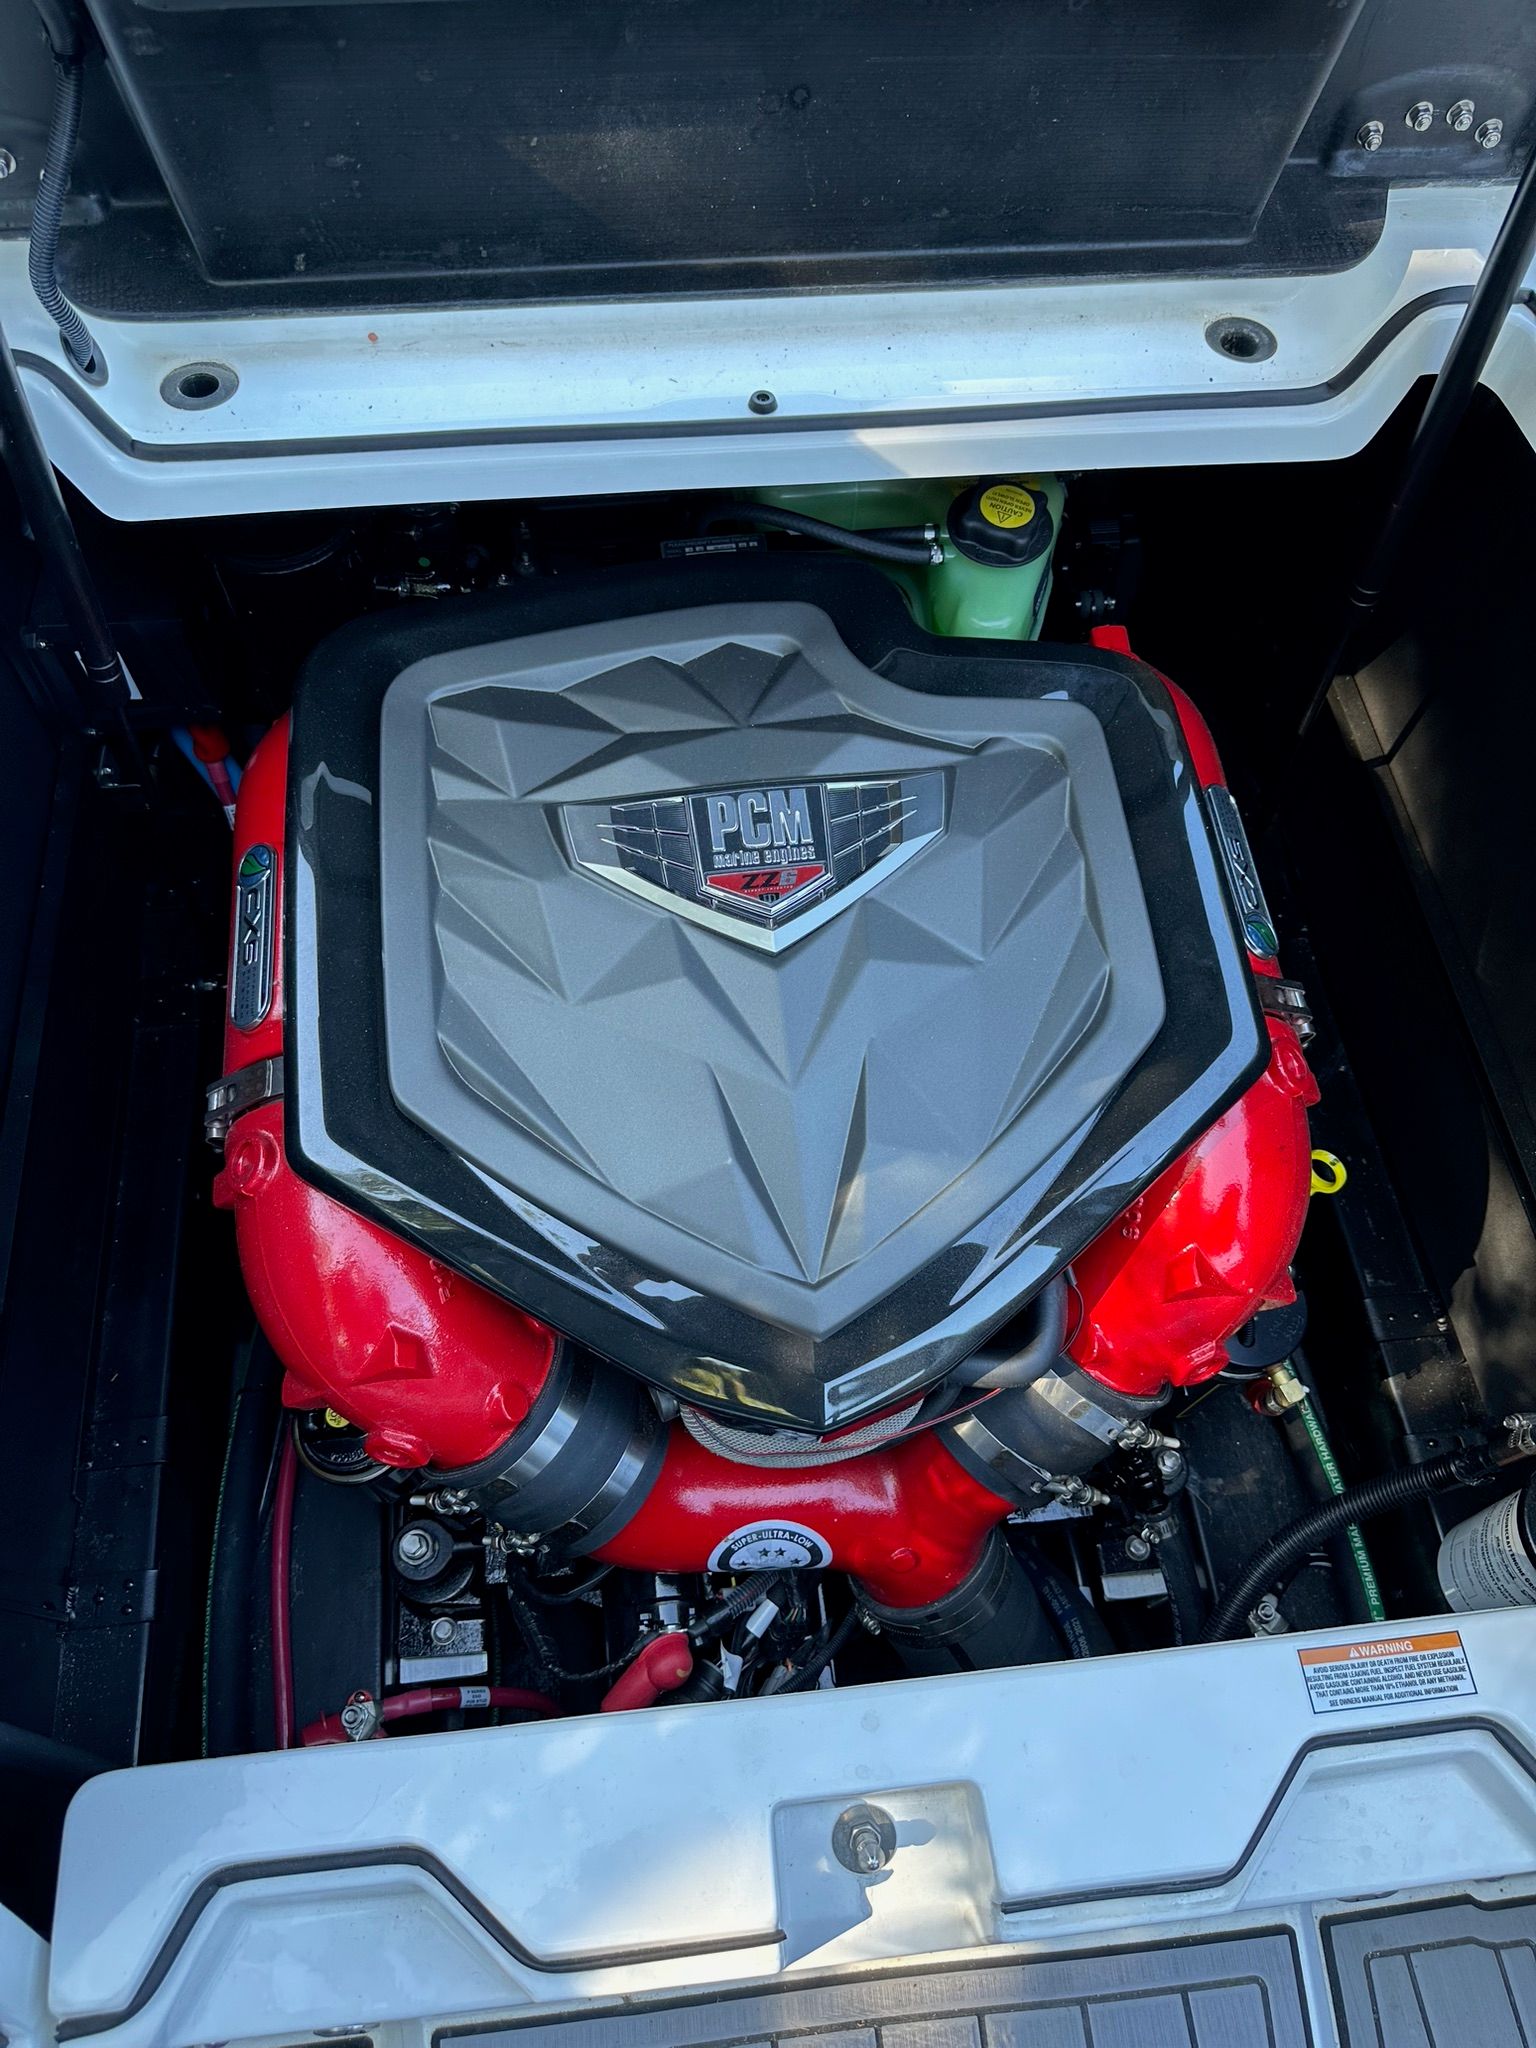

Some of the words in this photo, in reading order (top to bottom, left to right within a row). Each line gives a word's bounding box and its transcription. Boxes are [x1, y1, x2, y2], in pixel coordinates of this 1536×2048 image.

[989, 502, 1023, 517] CAUTION
[1014, 505, 1032, 514] NEVER
[1016, 498, 1030, 507] OPEN
[707, 788, 813, 851] PCM
[713, 850, 760, 868] marine
[764, 845, 816, 865] engines
[1326, 1462, 1345, 1494] ATER
[731, 1530, 814, 1551] SUPER-ULTRA-LOW
[1510, 1552, 1525, 1576] ENGINE
[1357, 1551, 1380, 1605] PREMIUM
[1358, 1640, 1413, 1657] WARNING
[1306, 1673, 1333, 1683] RESULTING
[1334, 1672, 1348, 1680] FROM
[1349, 1670, 1370, 1679] LEAKING
[1383, 1665, 1404, 1673] INSPECT
[1405, 1663, 1417, 1671] FUEL
[1417, 1661, 1437, 1669] SYSTEM
[1329, 1664, 1350, 1672] SERIOUS
[1350, 1661, 1368, 1670] INJURY
[1377, 1658, 1393, 1666] DEATH
[1394, 1656, 1408, 1664] FROM
[1409, 1655, 1418, 1663] FIRE
[1427, 1651, 1455, 1660] EXPLOSION
[1310, 1683, 1325, 1691] AVOID
[1326, 1680, 1350, 1689] GASOLINE
[1350, 1676, 1381, 1687] CONTAINING
[1382, 1673, 1404, 1682] ALCOHOL
[1405, 1672, 1415, 1680] AND
[1416, 1669, 1432, 1678] NEVER
[1433, 1668, 1442, 1676] USE
[1443, 1665, 1467, 1674] GASOLINE
[1315, 1690, 1328, 1698] THAT
[1329, 1687, 1355, 1697] CONTAINS
[1356, 1685, 1370, 1693] MORE
[1371, 1683, 1385, 1691] THAN
[1385, 1681, 1395, 1690] 10%
[1395, 1679, 1418, 1688] ETHANOL
[1427, 1676, 1437, 1684] ANY
[1329, 1699, 1339, 1707] SEE
[1340, 1696, 1361, 1706] OWNERS
[1361, 1693, 1384, 1703] MANUAL
[1384, 1692, 1394, 1700] FOR
[1395, 1688, 1423, 1699] ADDITIONAL
[1424, 1684, 1459, 1695] INFORMATION
